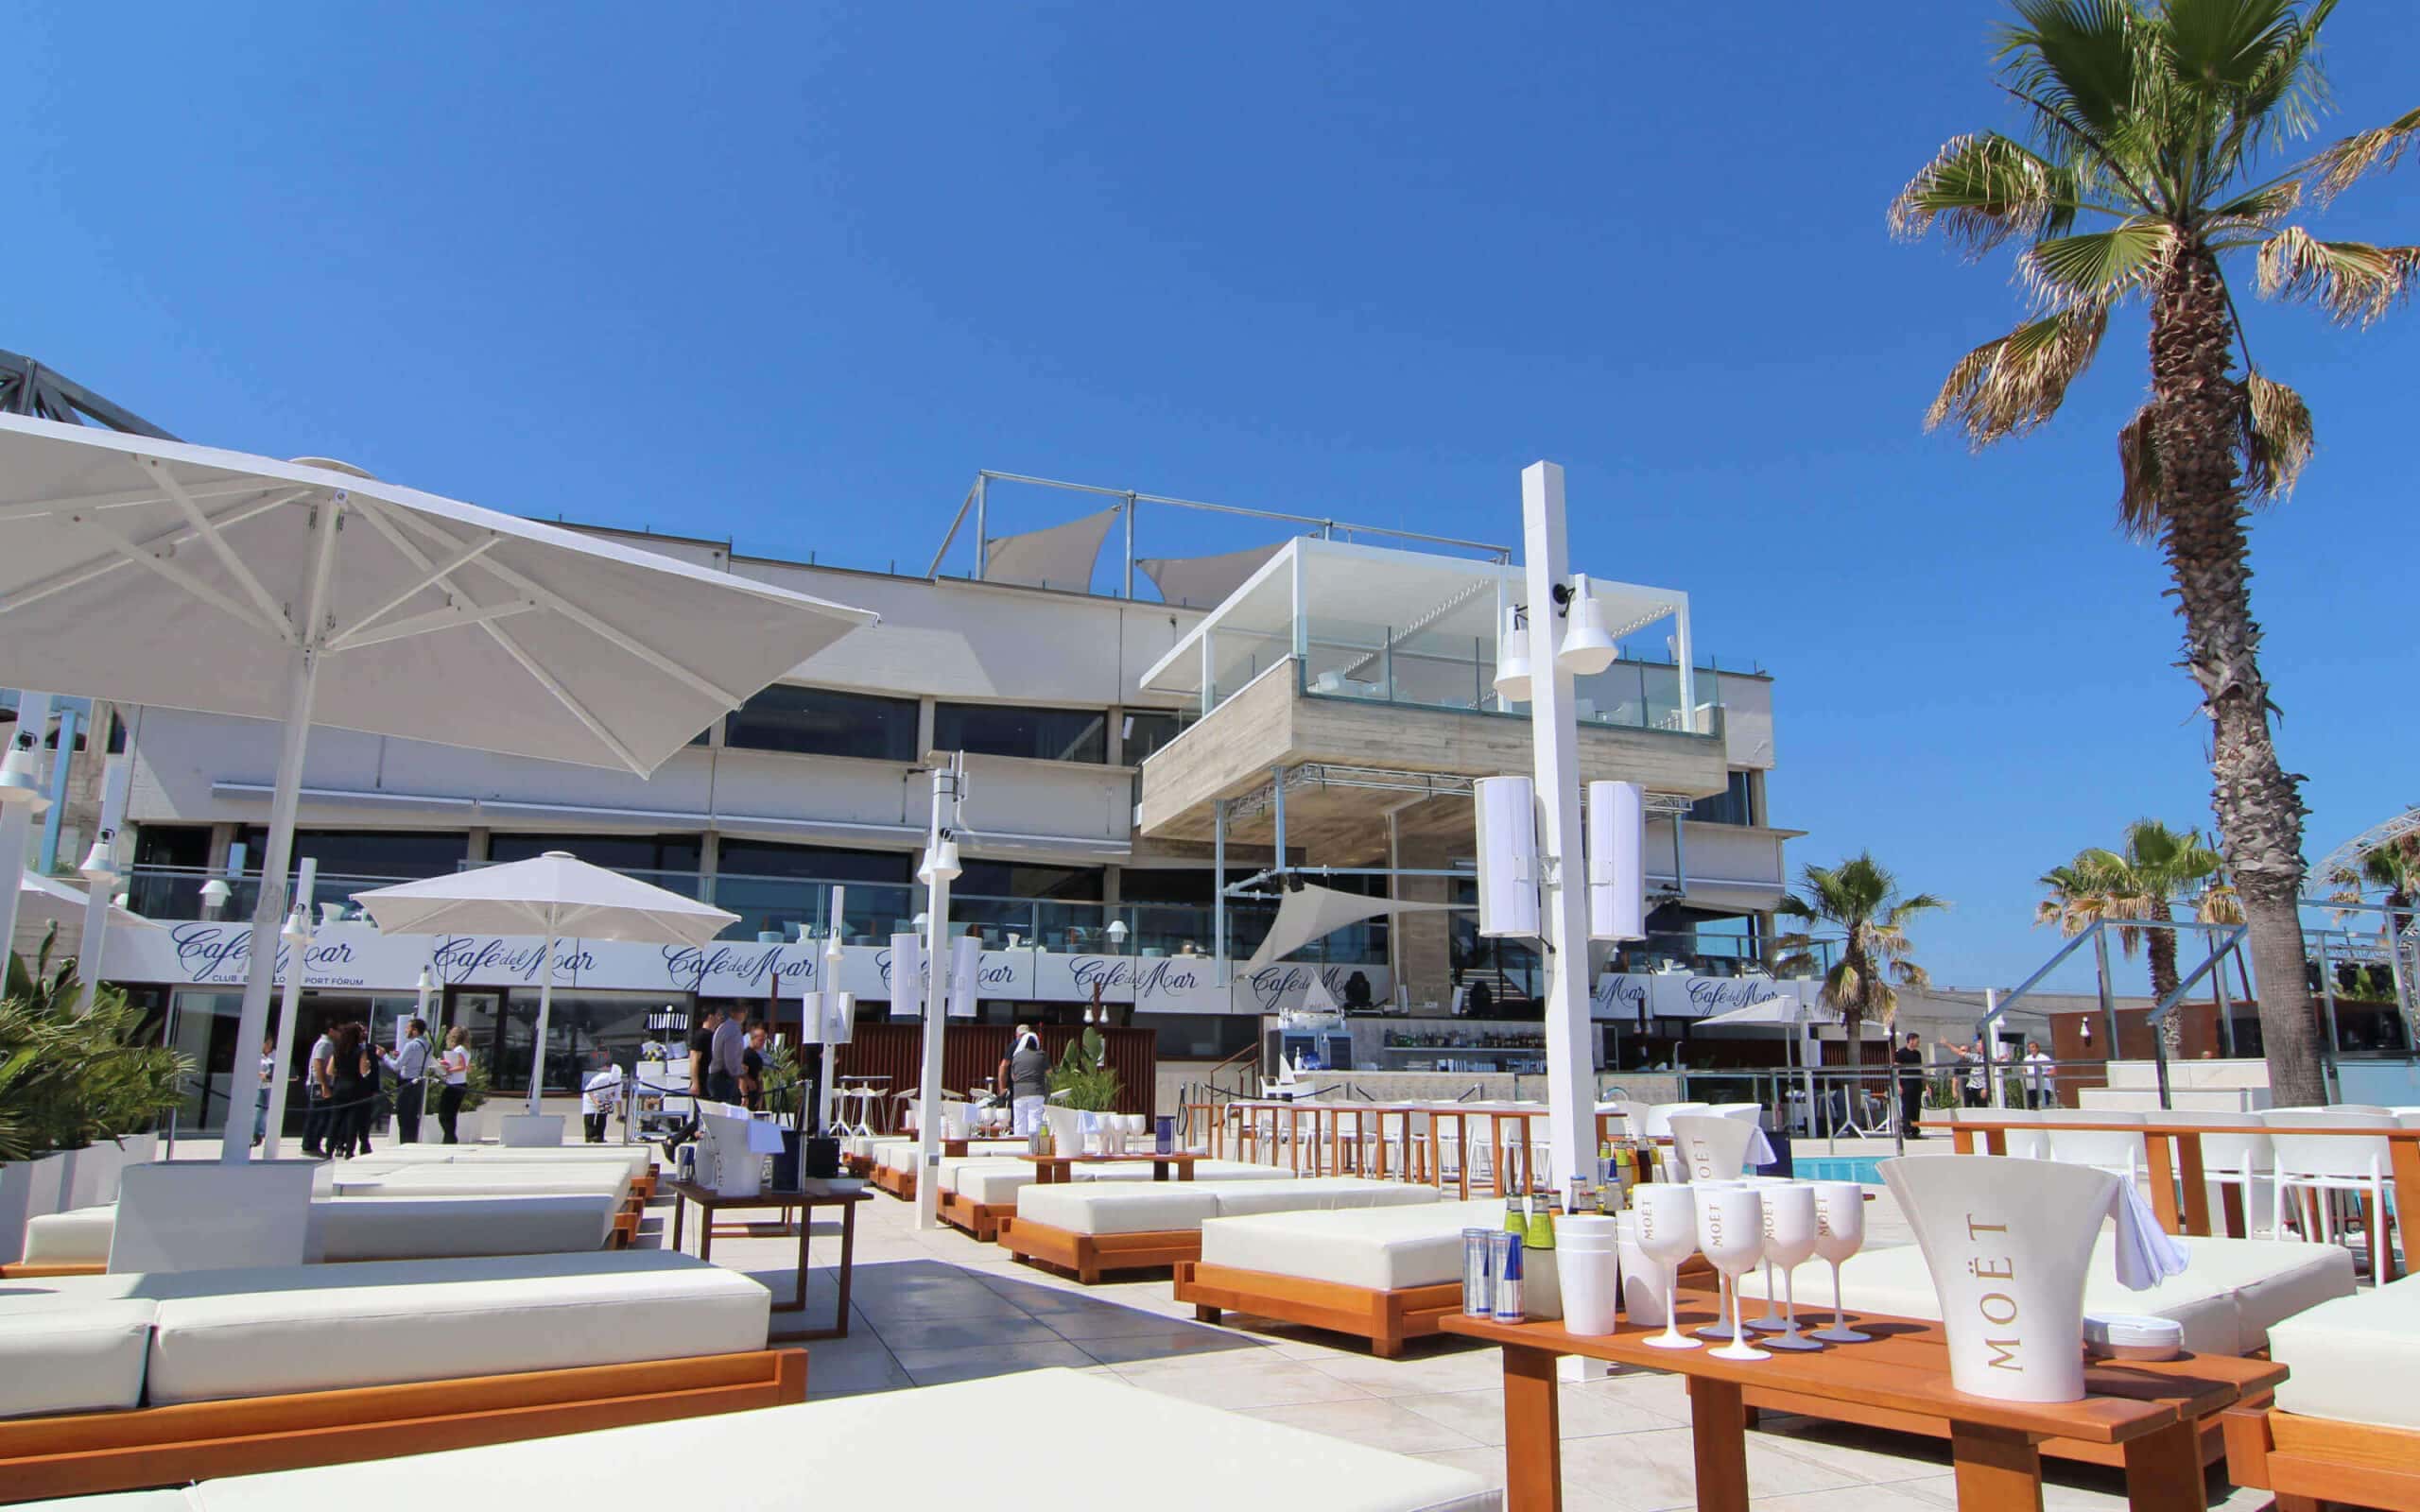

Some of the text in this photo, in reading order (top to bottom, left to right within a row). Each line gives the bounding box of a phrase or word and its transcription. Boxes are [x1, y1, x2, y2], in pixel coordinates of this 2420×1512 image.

[662, 945, 817, 990] Café del Mar
[1069, 955, 1127, 1002] Café
[1134, 960, 1199, 998] Mar
[1966, 1212, 2023, 1372] MOËT
